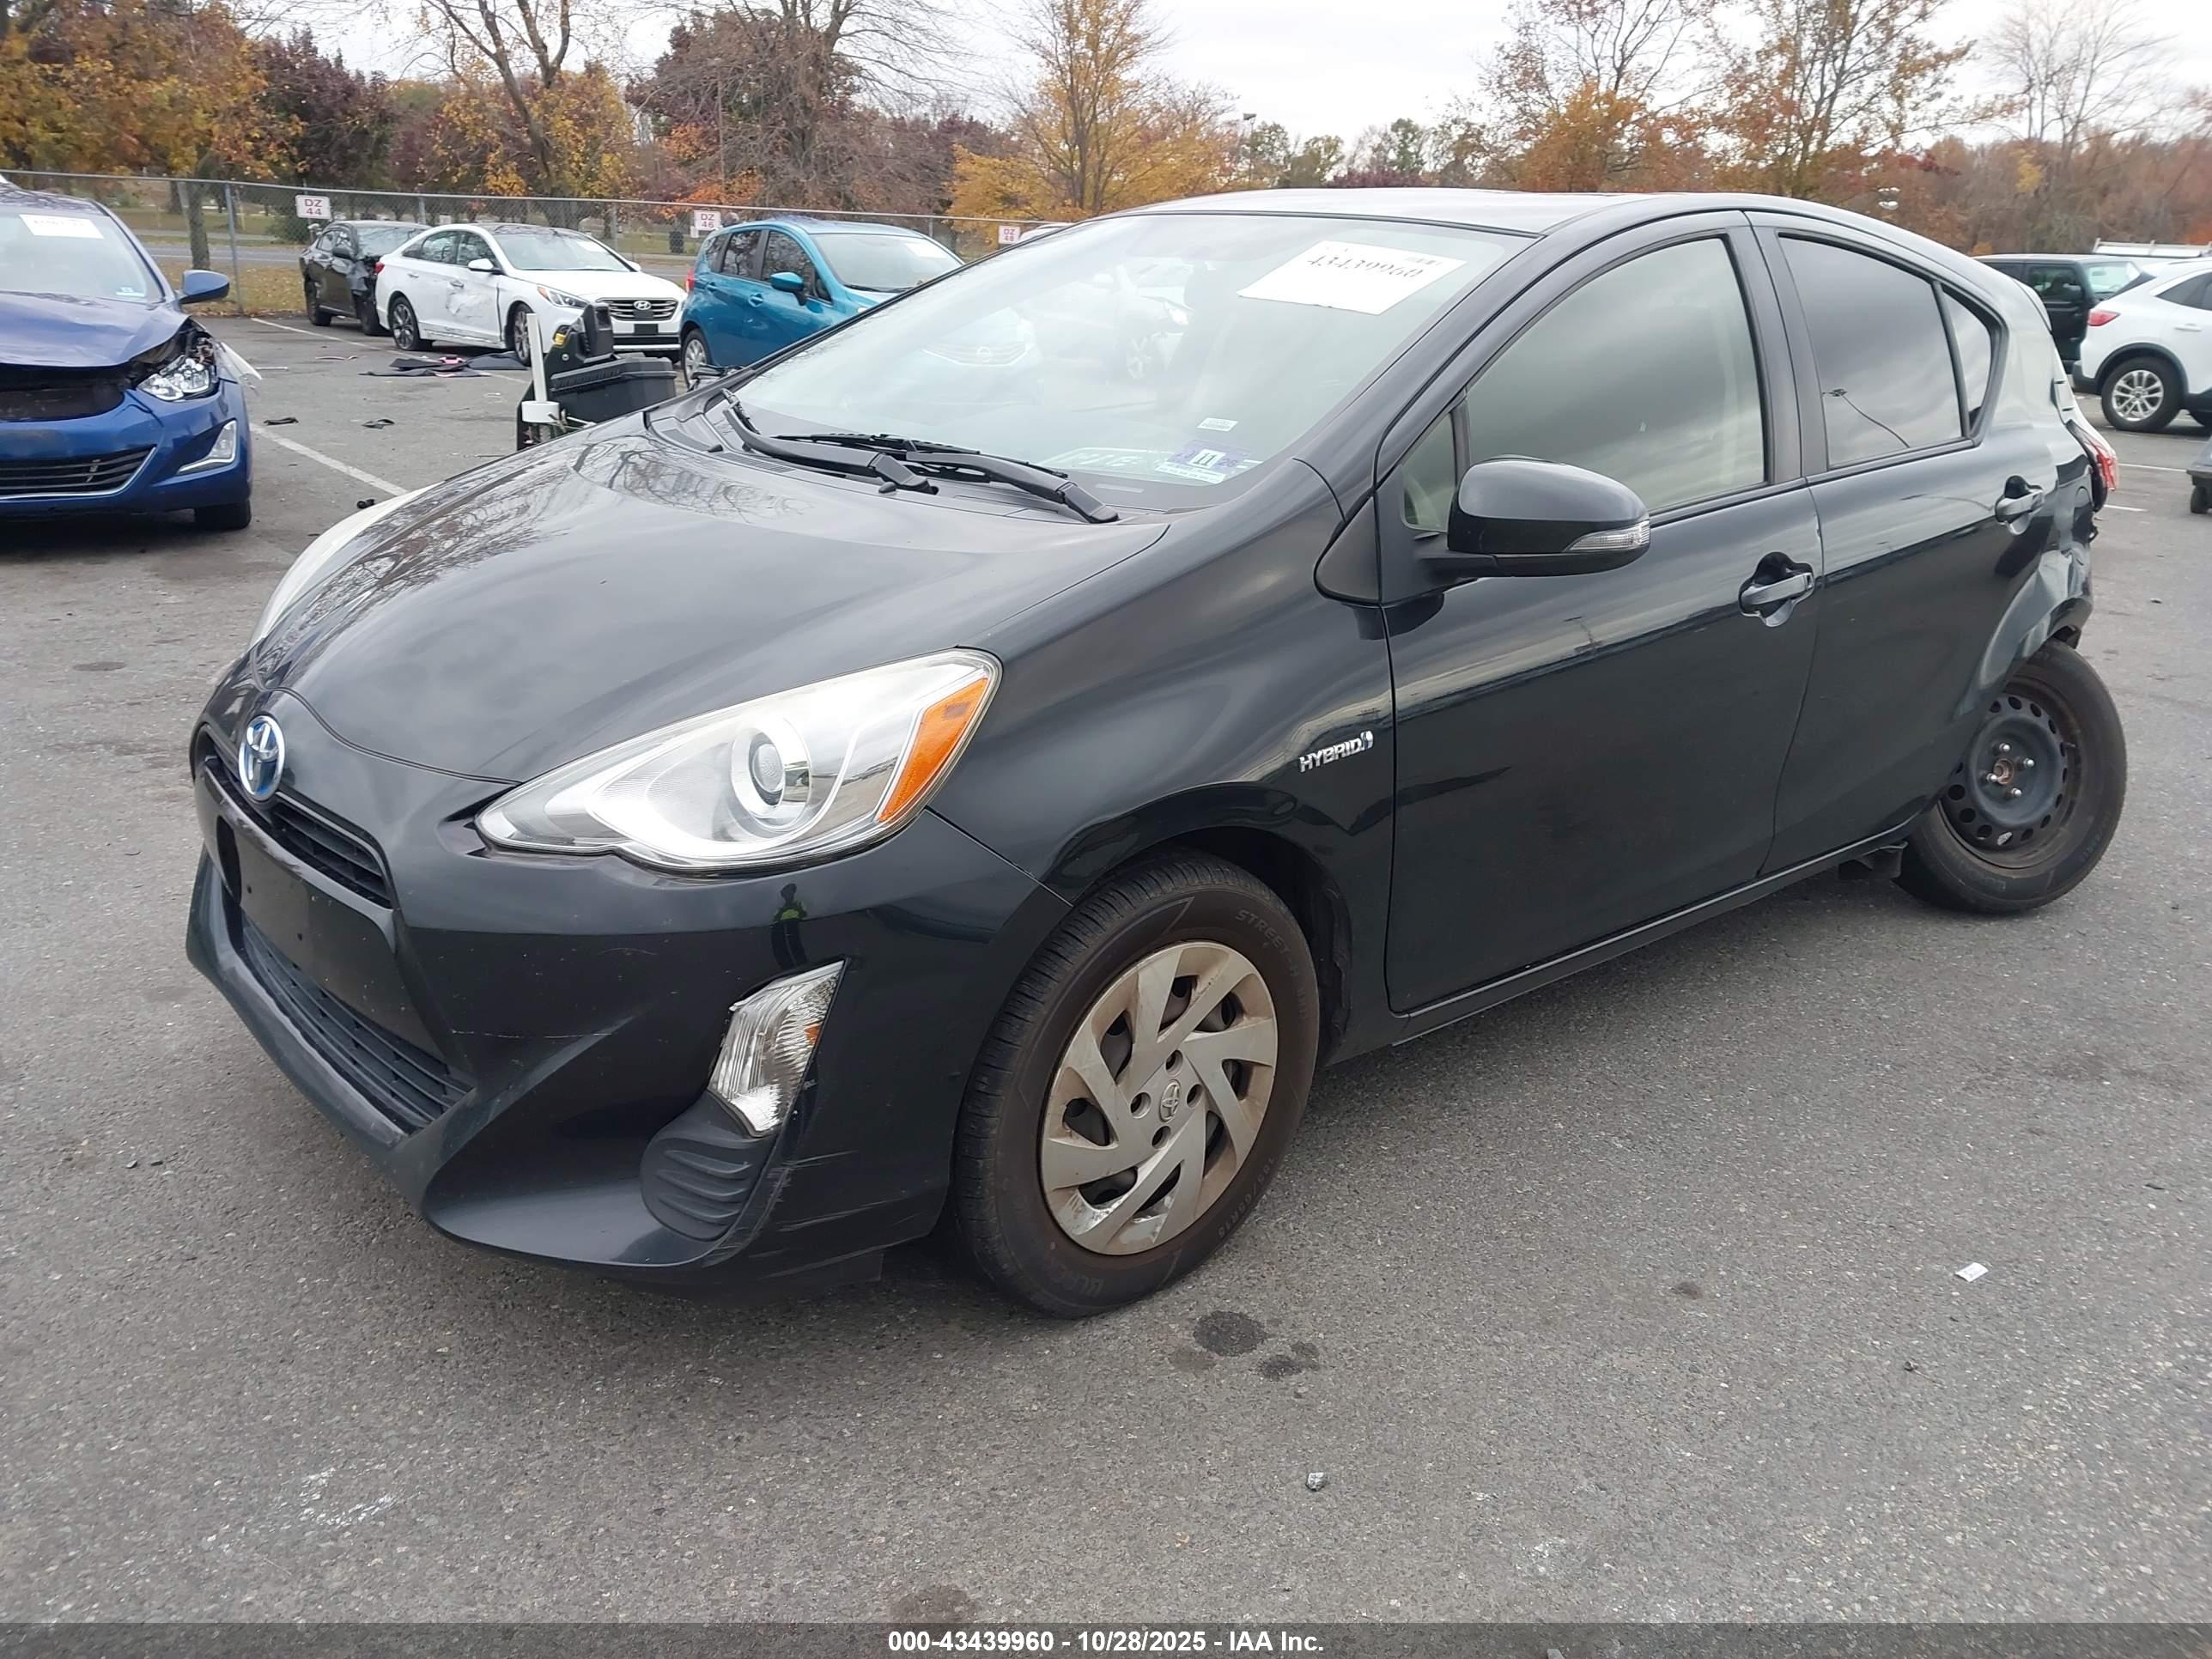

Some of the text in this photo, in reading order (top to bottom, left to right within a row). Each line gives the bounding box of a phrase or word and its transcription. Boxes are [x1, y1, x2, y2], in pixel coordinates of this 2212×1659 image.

[304, 198, 323, 207] DZ
[1193, 453, 1217, 466] 11
[1299, 737, 1364, 773] HYBRID
